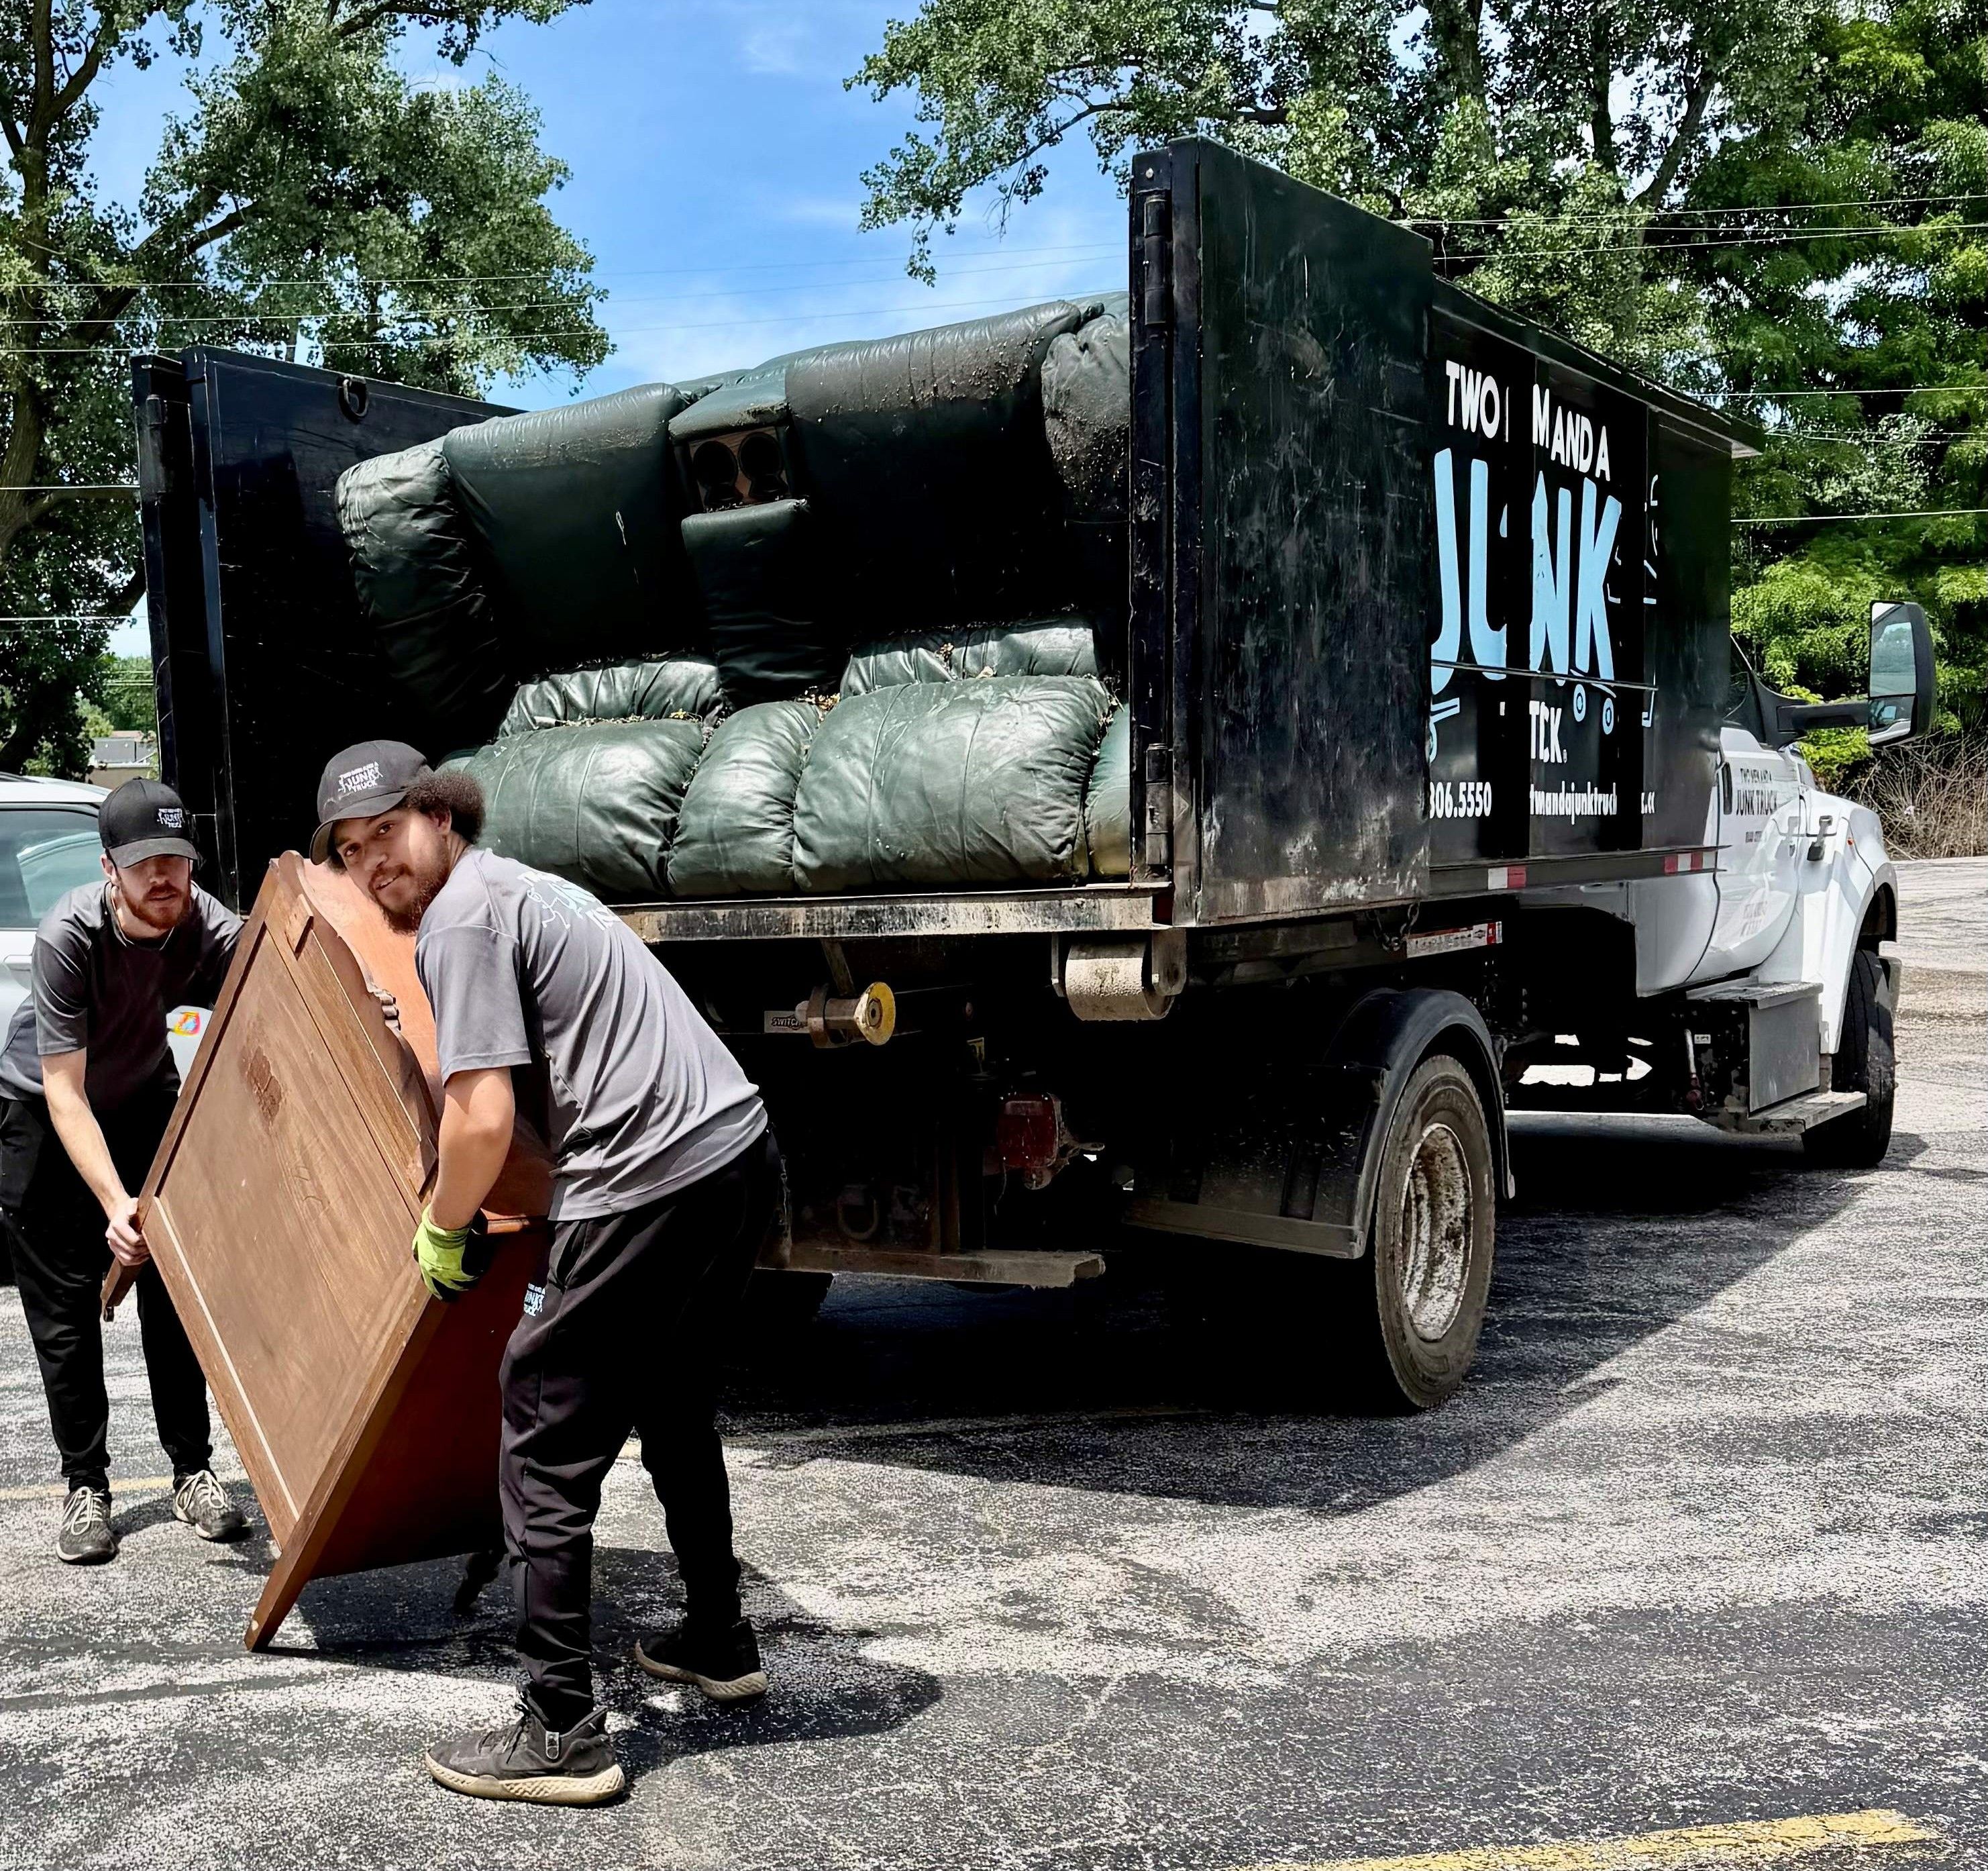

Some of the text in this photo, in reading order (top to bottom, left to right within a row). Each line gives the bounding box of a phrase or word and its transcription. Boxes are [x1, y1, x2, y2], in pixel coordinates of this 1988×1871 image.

[1446, 360, 1500, 439] TWO
[1551, 405, 1593, 473] AND
[1595, 425, 1610, 482] A
[345, 768, 378, 788] JUNK
[1736, 790, 1755, 816] JUNK
